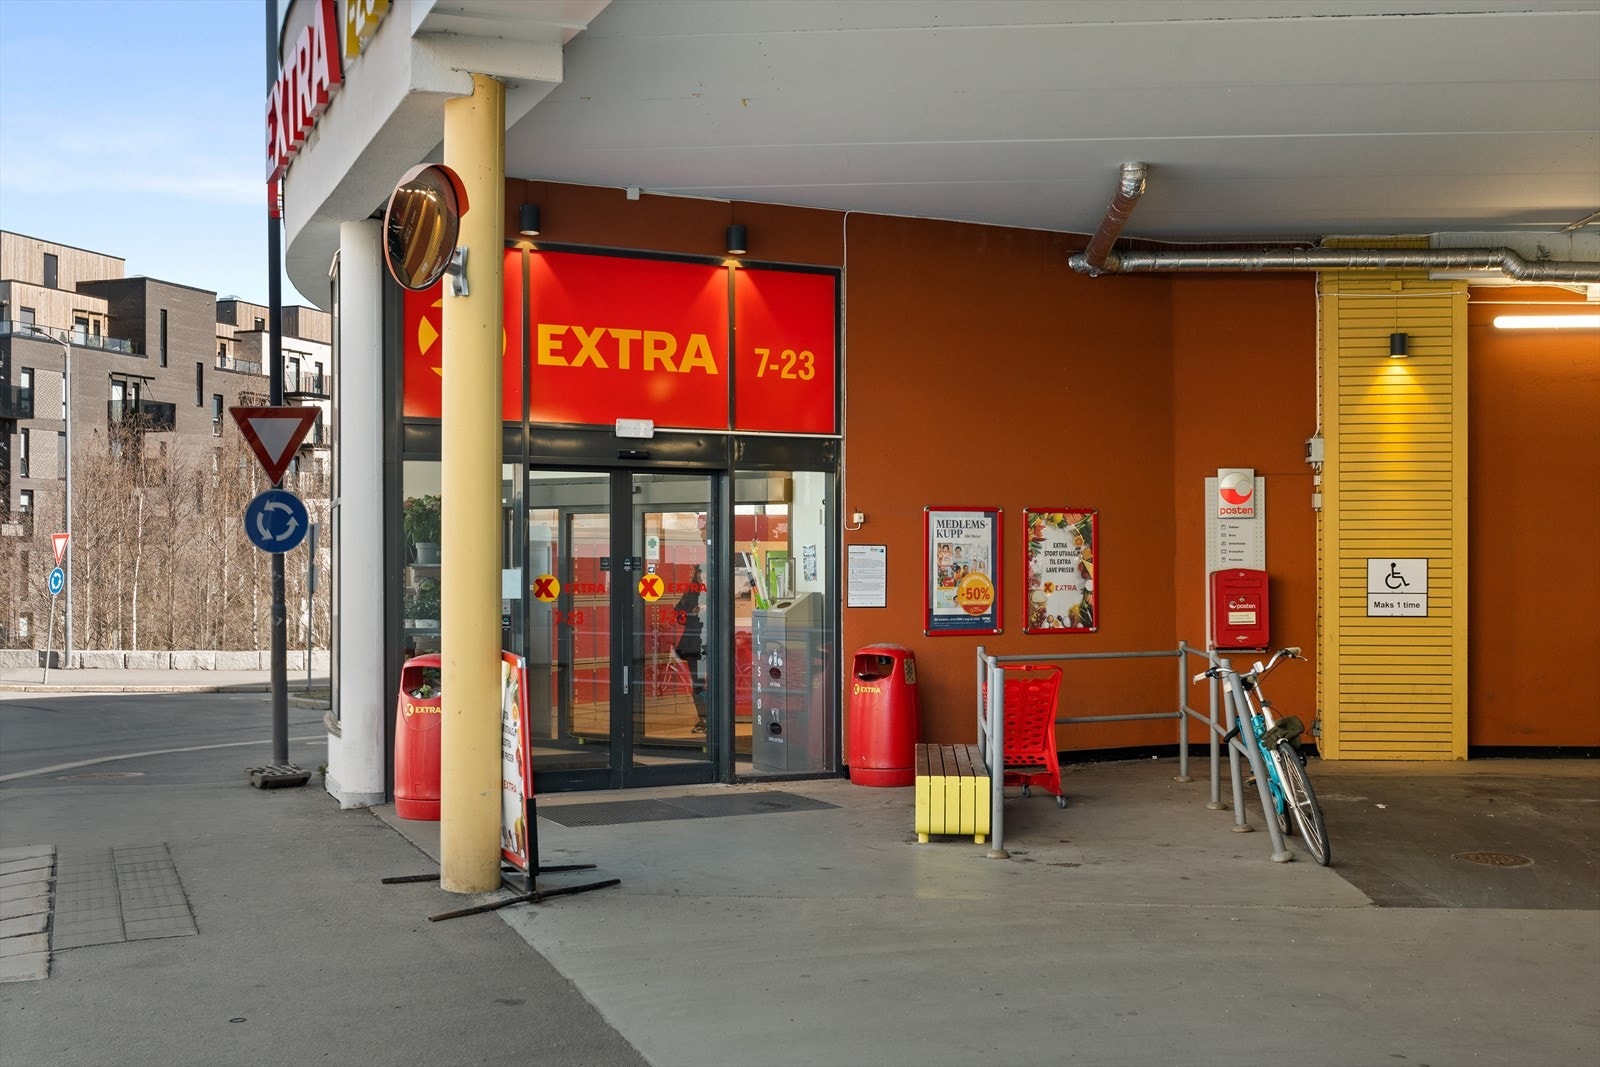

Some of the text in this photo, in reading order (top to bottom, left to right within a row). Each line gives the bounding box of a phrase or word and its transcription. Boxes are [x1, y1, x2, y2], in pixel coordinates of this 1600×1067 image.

[266, 0, 340, 184] EXTRA
[537, 323, 719, 375] EXTRA
[754, 347, 816, 381] 7-23
[1220, 506, 1253, 516] posten
[936, 519, 989, 529] MEDLEMS-
[936, 529, 963, 538] KUPP
[564, 583, 606, 593] EXTRA
[667, 583, 707, 593] EXTRA
[961, 587, 990, 600] -50%
[554, 611, 584, 625] 7-23
[659, 610, 687, 625] 7-23
[415, 706, 441, 714] EXTRA
[503, 780, 516, 792] EXTRA
